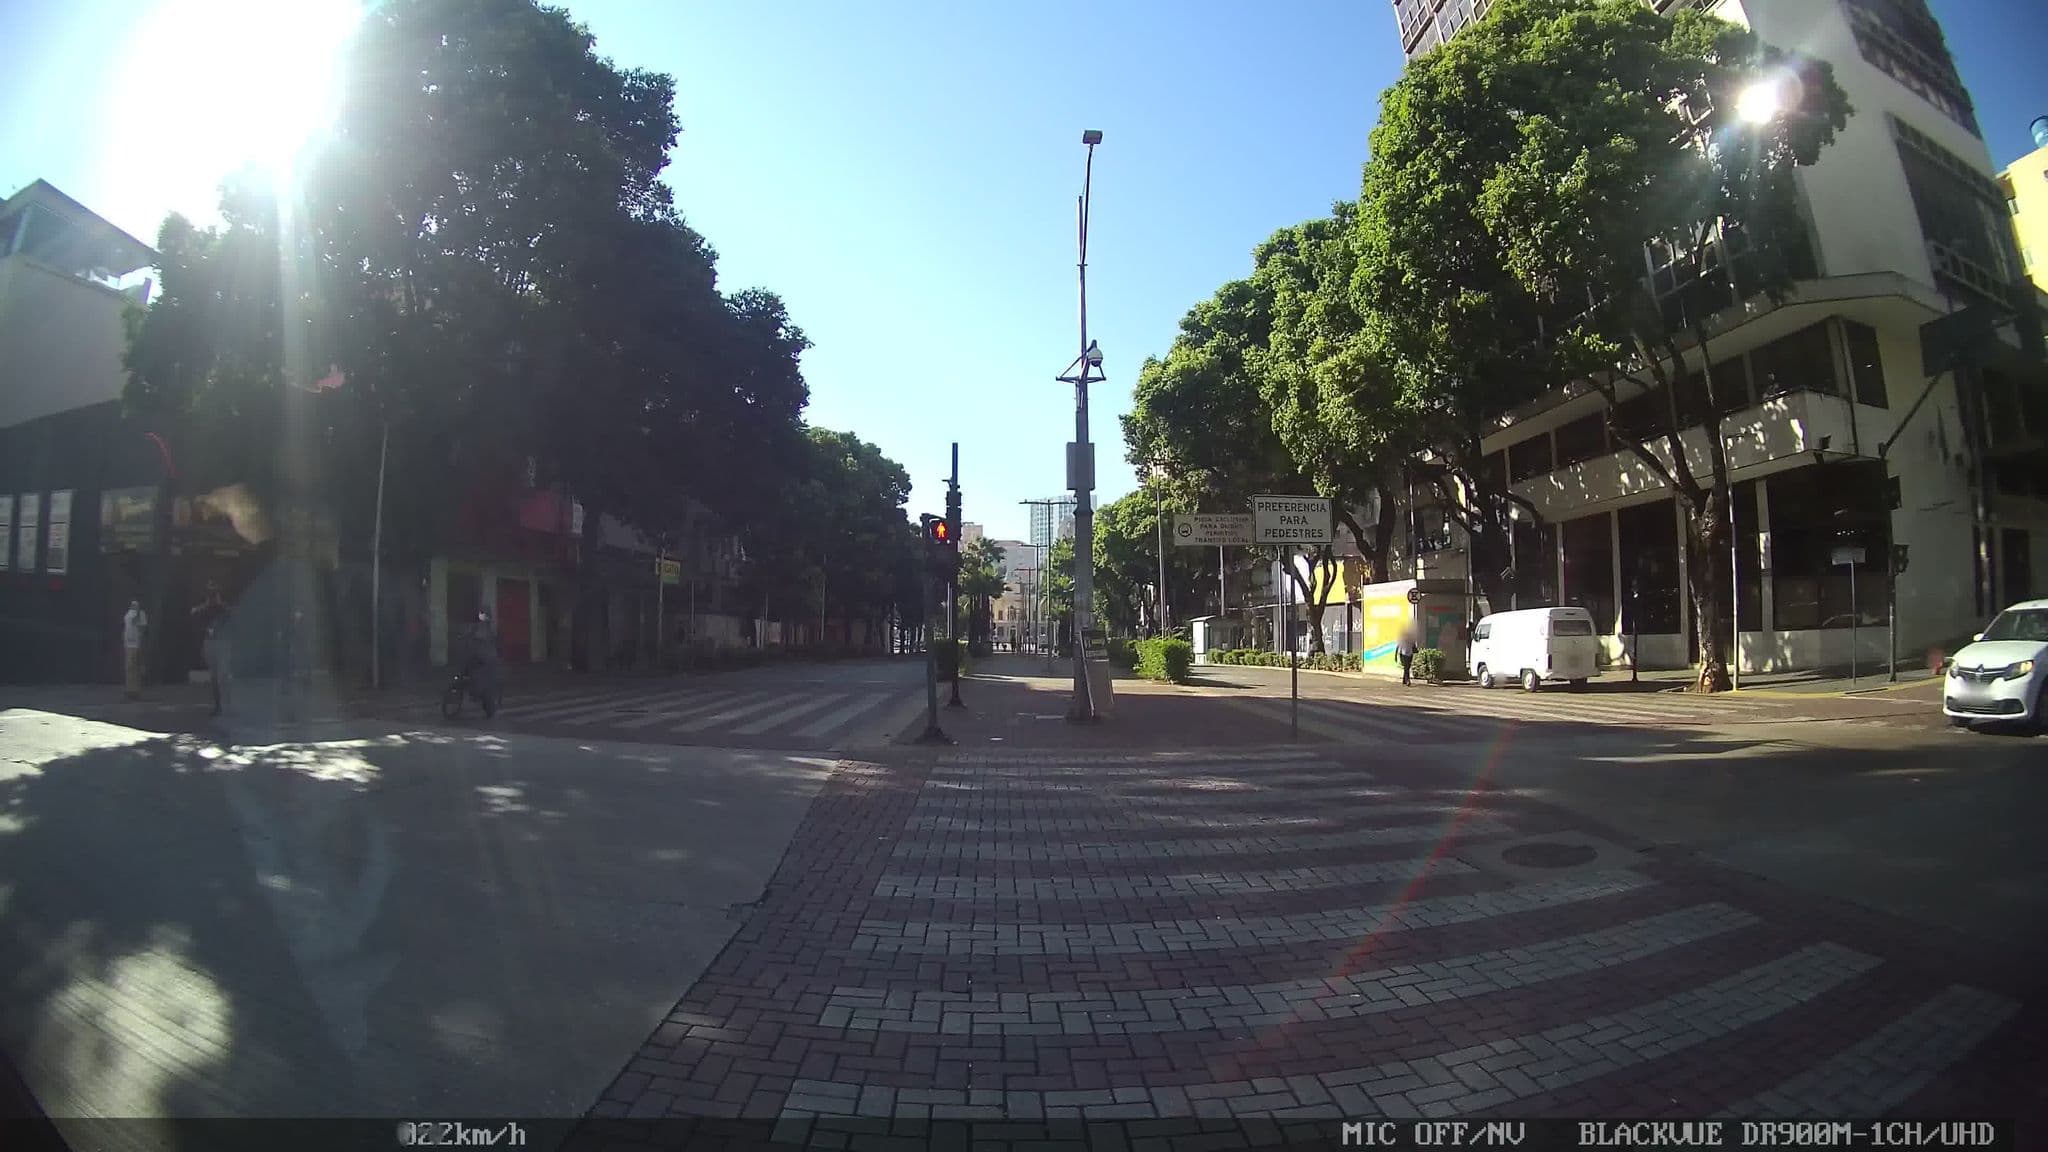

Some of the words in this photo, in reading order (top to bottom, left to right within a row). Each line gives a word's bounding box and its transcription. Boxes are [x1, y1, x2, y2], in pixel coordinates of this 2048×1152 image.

[1257, 502, 1327, 512] PREFERENCIA
[1280, 515, 1308, 525] PARA
[1265, 528, 1323, 538] PEDESTRES
